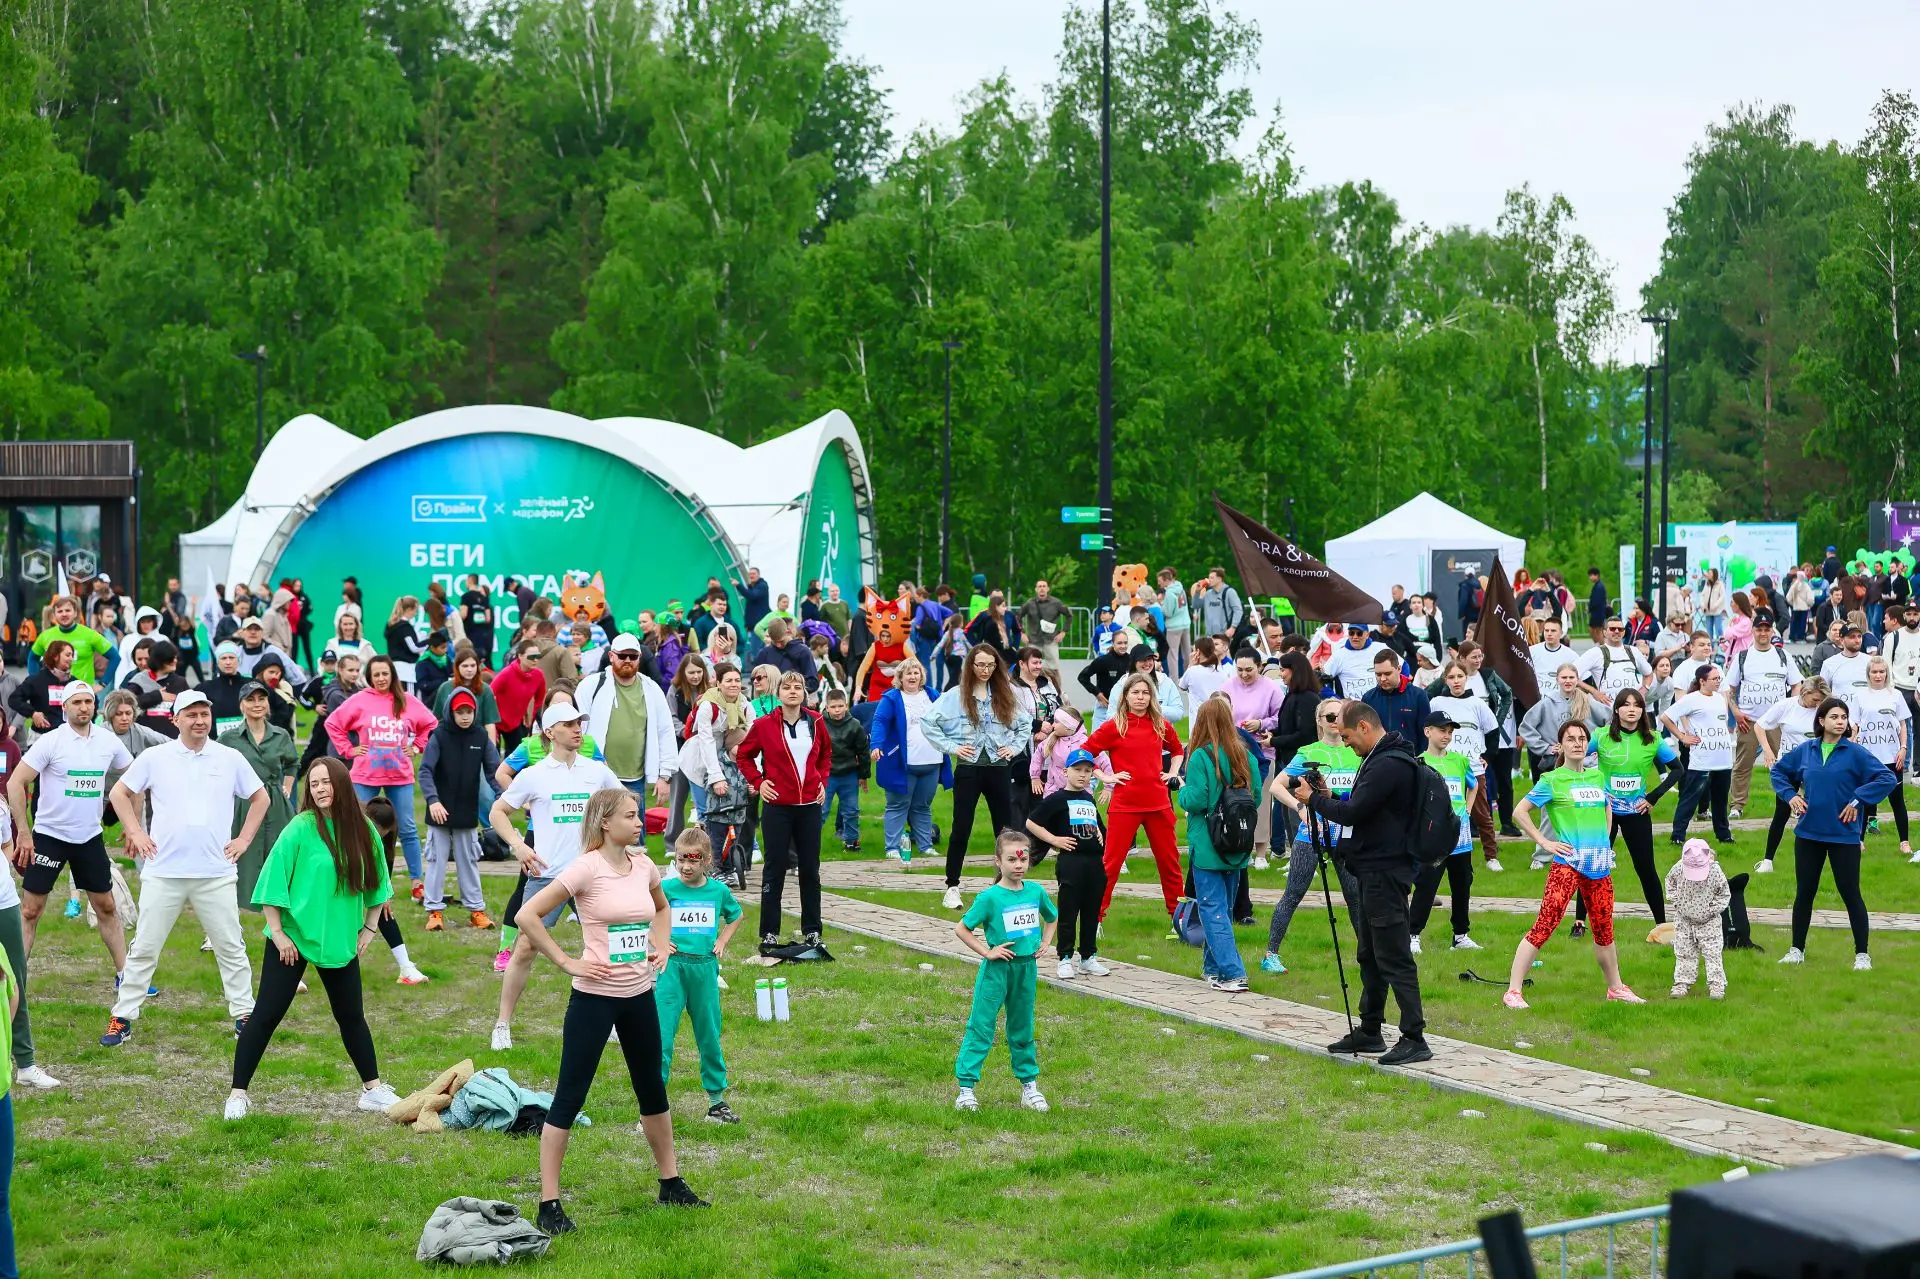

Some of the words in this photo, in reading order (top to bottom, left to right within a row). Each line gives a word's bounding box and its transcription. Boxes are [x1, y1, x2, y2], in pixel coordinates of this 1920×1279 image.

[434, 501, 476, 515] Прайм
[512, 508, 564, 520] марафон
[410, 543, 485, 567] БЕГИ
[1286, 544, 1302, 561] &
[75, 779, 97, 788] 1990
[1331, 776, 1352, 785] 0126
[1616, 780, 1636, 788] 0097
[1579, 790, 1600, 798] 0210
[561, 803, 584, 813] 1705
[1076, 807, 1095, 817] 4515
[34, 852, 61, 868] TERMIT
[679, 912, 708, 923] 4616
[1013, 913, 1036, 925] 4520
[620, 935, 646, 949] 1217
